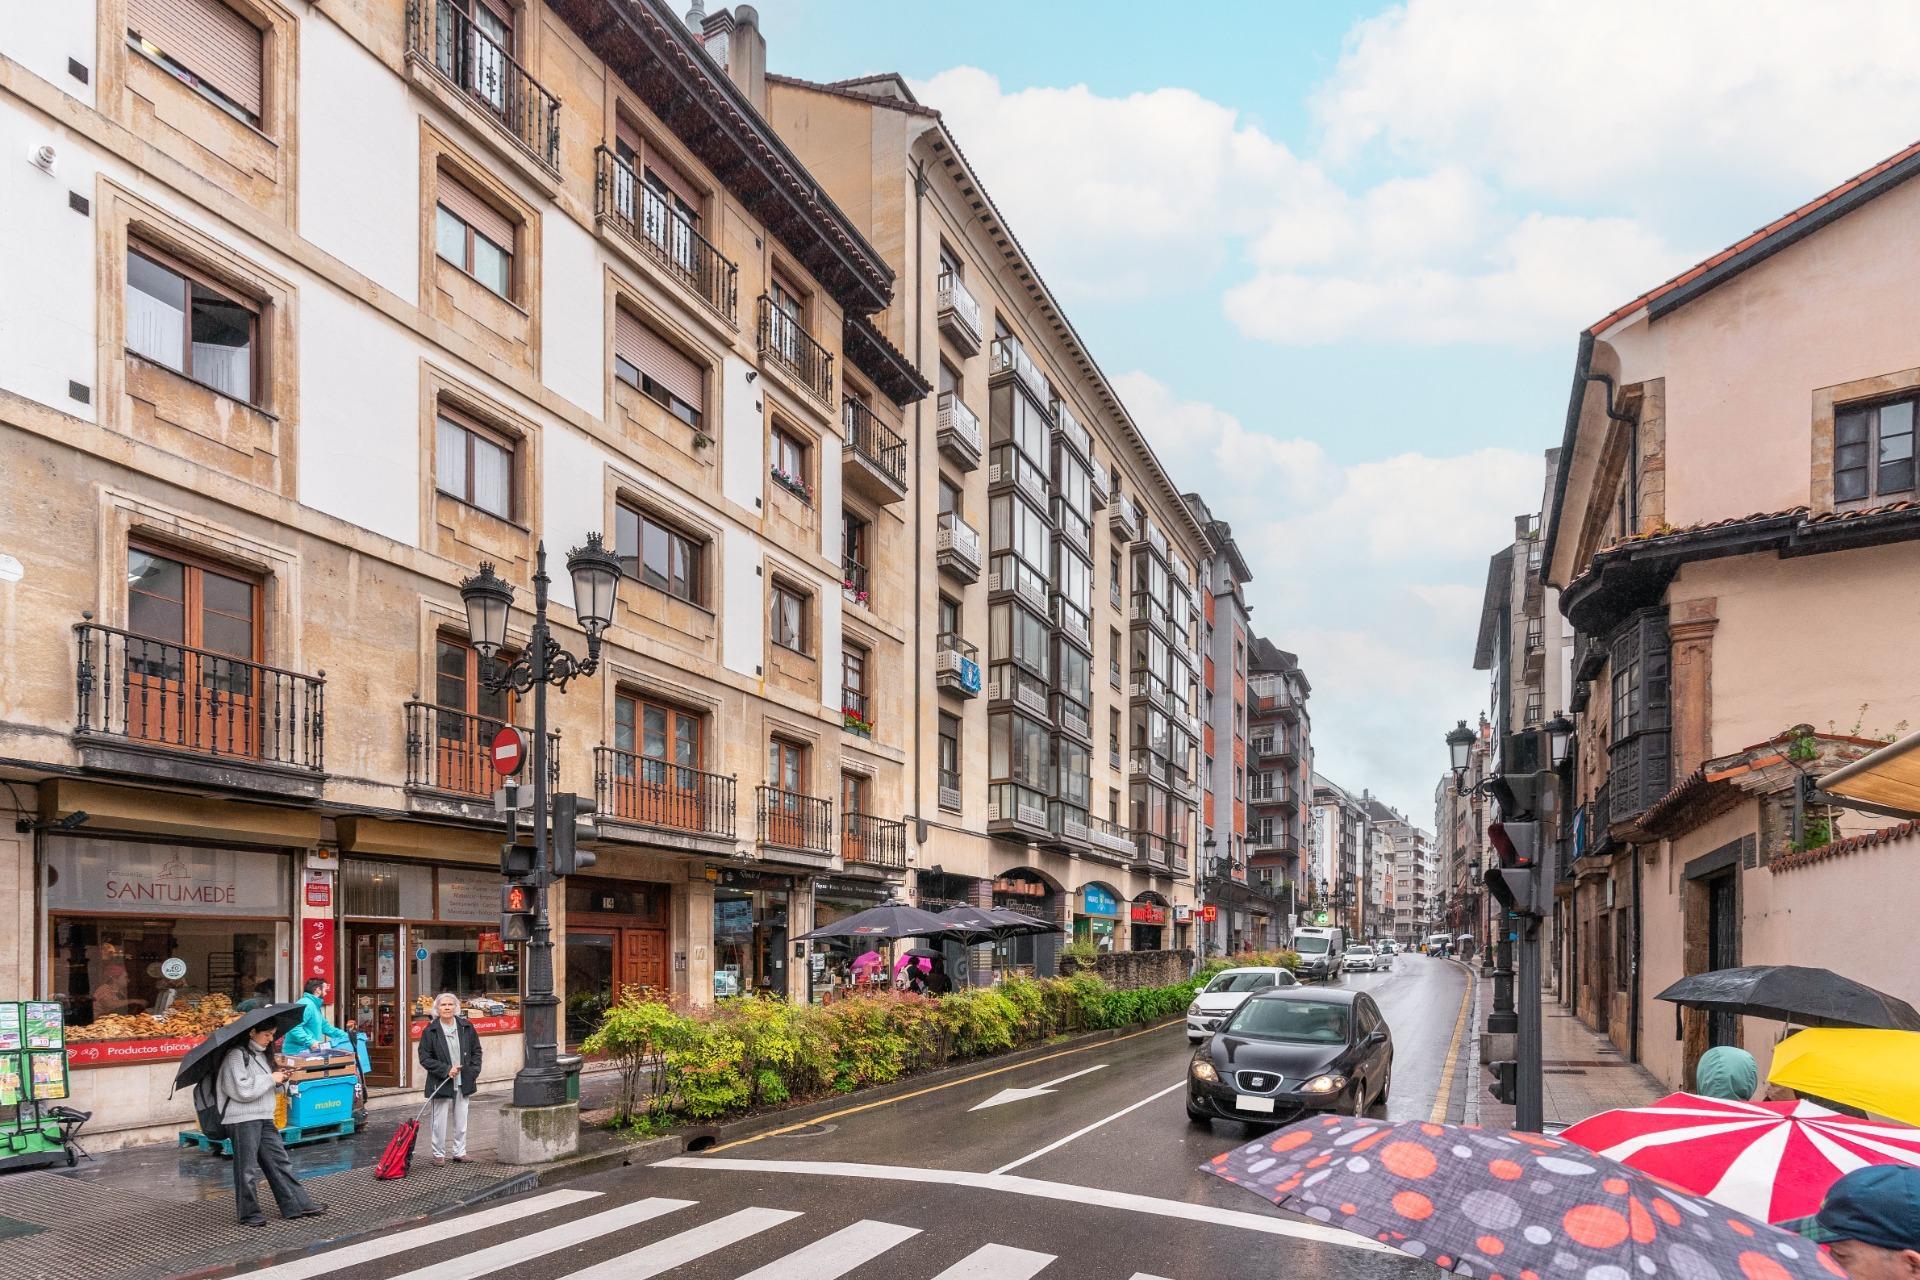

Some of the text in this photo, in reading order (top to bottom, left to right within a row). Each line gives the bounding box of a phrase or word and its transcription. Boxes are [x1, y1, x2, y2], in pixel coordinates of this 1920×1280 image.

[106, 880, 236, 904] SANTUMEDÉ
[107, 1045, 158, 1056] Productos
[159, 1041, 191, 1054] típicos
